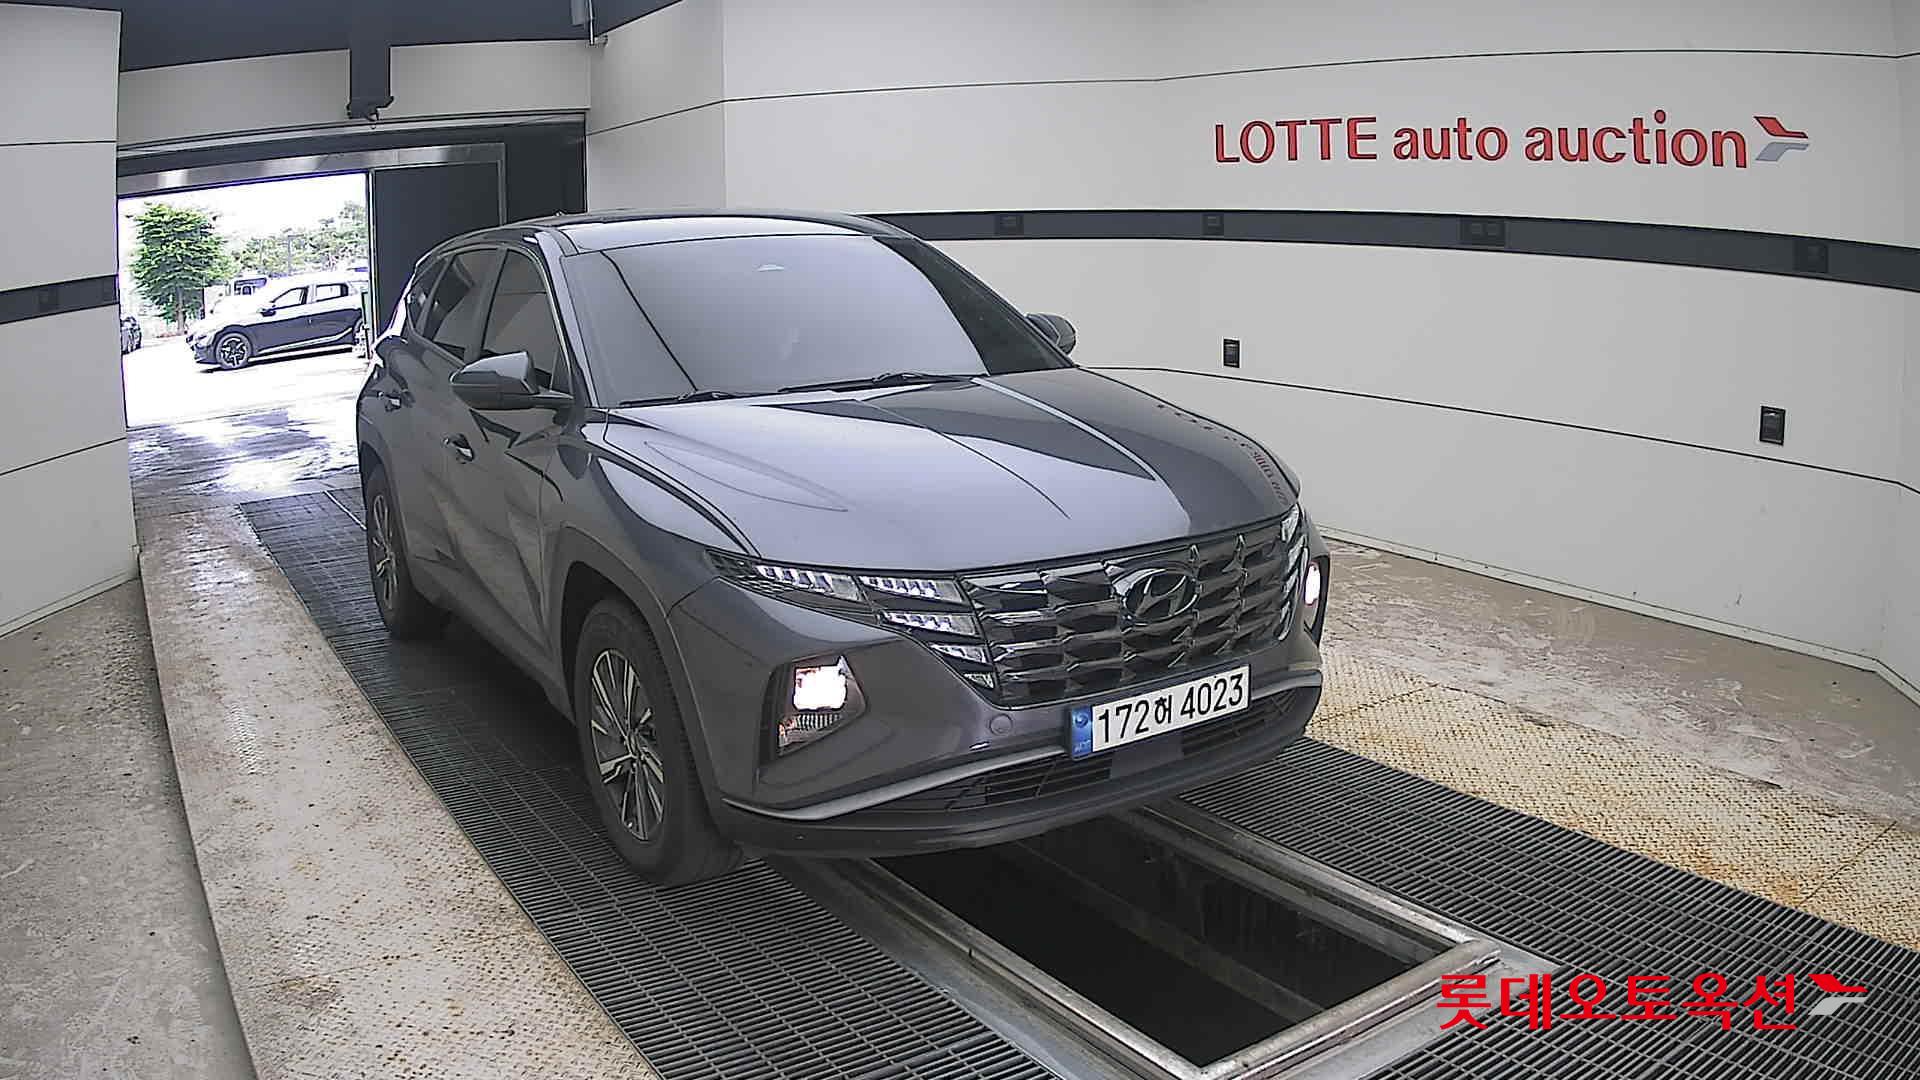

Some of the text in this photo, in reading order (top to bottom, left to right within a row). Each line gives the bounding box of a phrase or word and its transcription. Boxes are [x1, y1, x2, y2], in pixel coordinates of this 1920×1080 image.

[1215, 110, 1747, 168] LOTTE auto auction
[1099, 673, 1243, 743] 172허 4023
